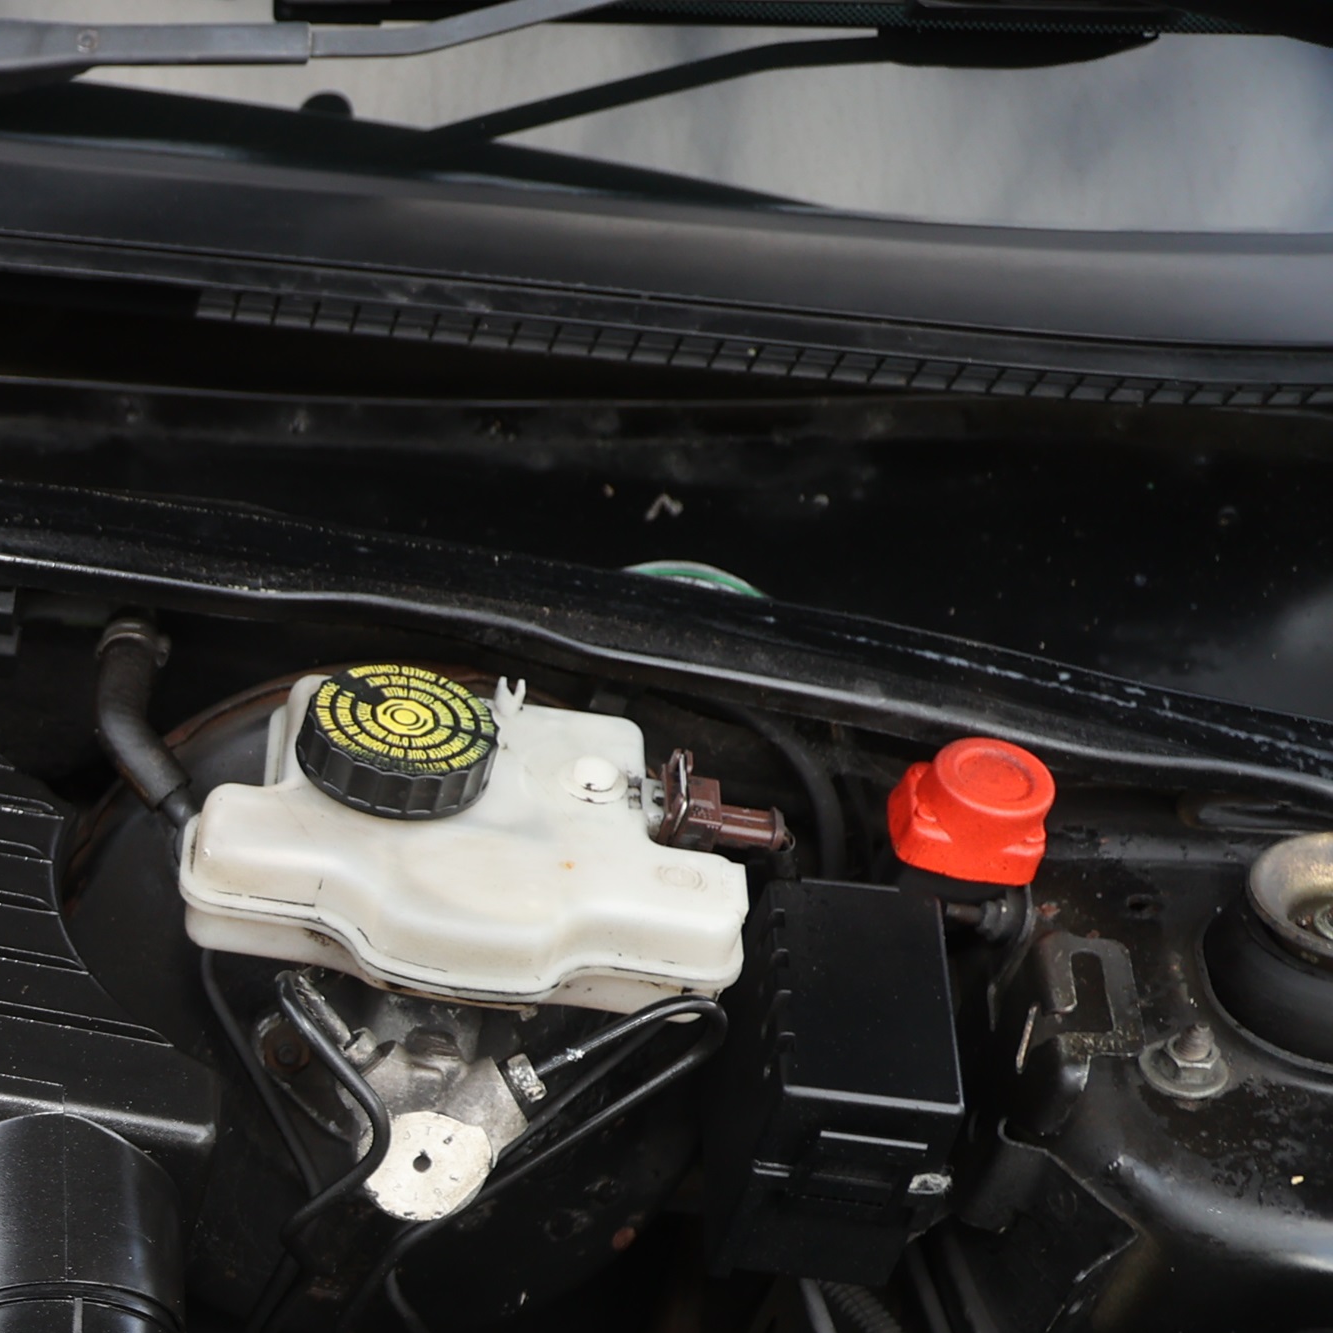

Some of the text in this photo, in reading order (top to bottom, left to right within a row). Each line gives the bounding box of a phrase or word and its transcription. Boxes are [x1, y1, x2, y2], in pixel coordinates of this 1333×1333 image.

[390, 674, 408, 686] USE
[401, 665, 438, 682] SEALED
[437, 676, 449, 686] A
[390, 744, 405, 759] DU
[407, 748, 428, 761] QUE
